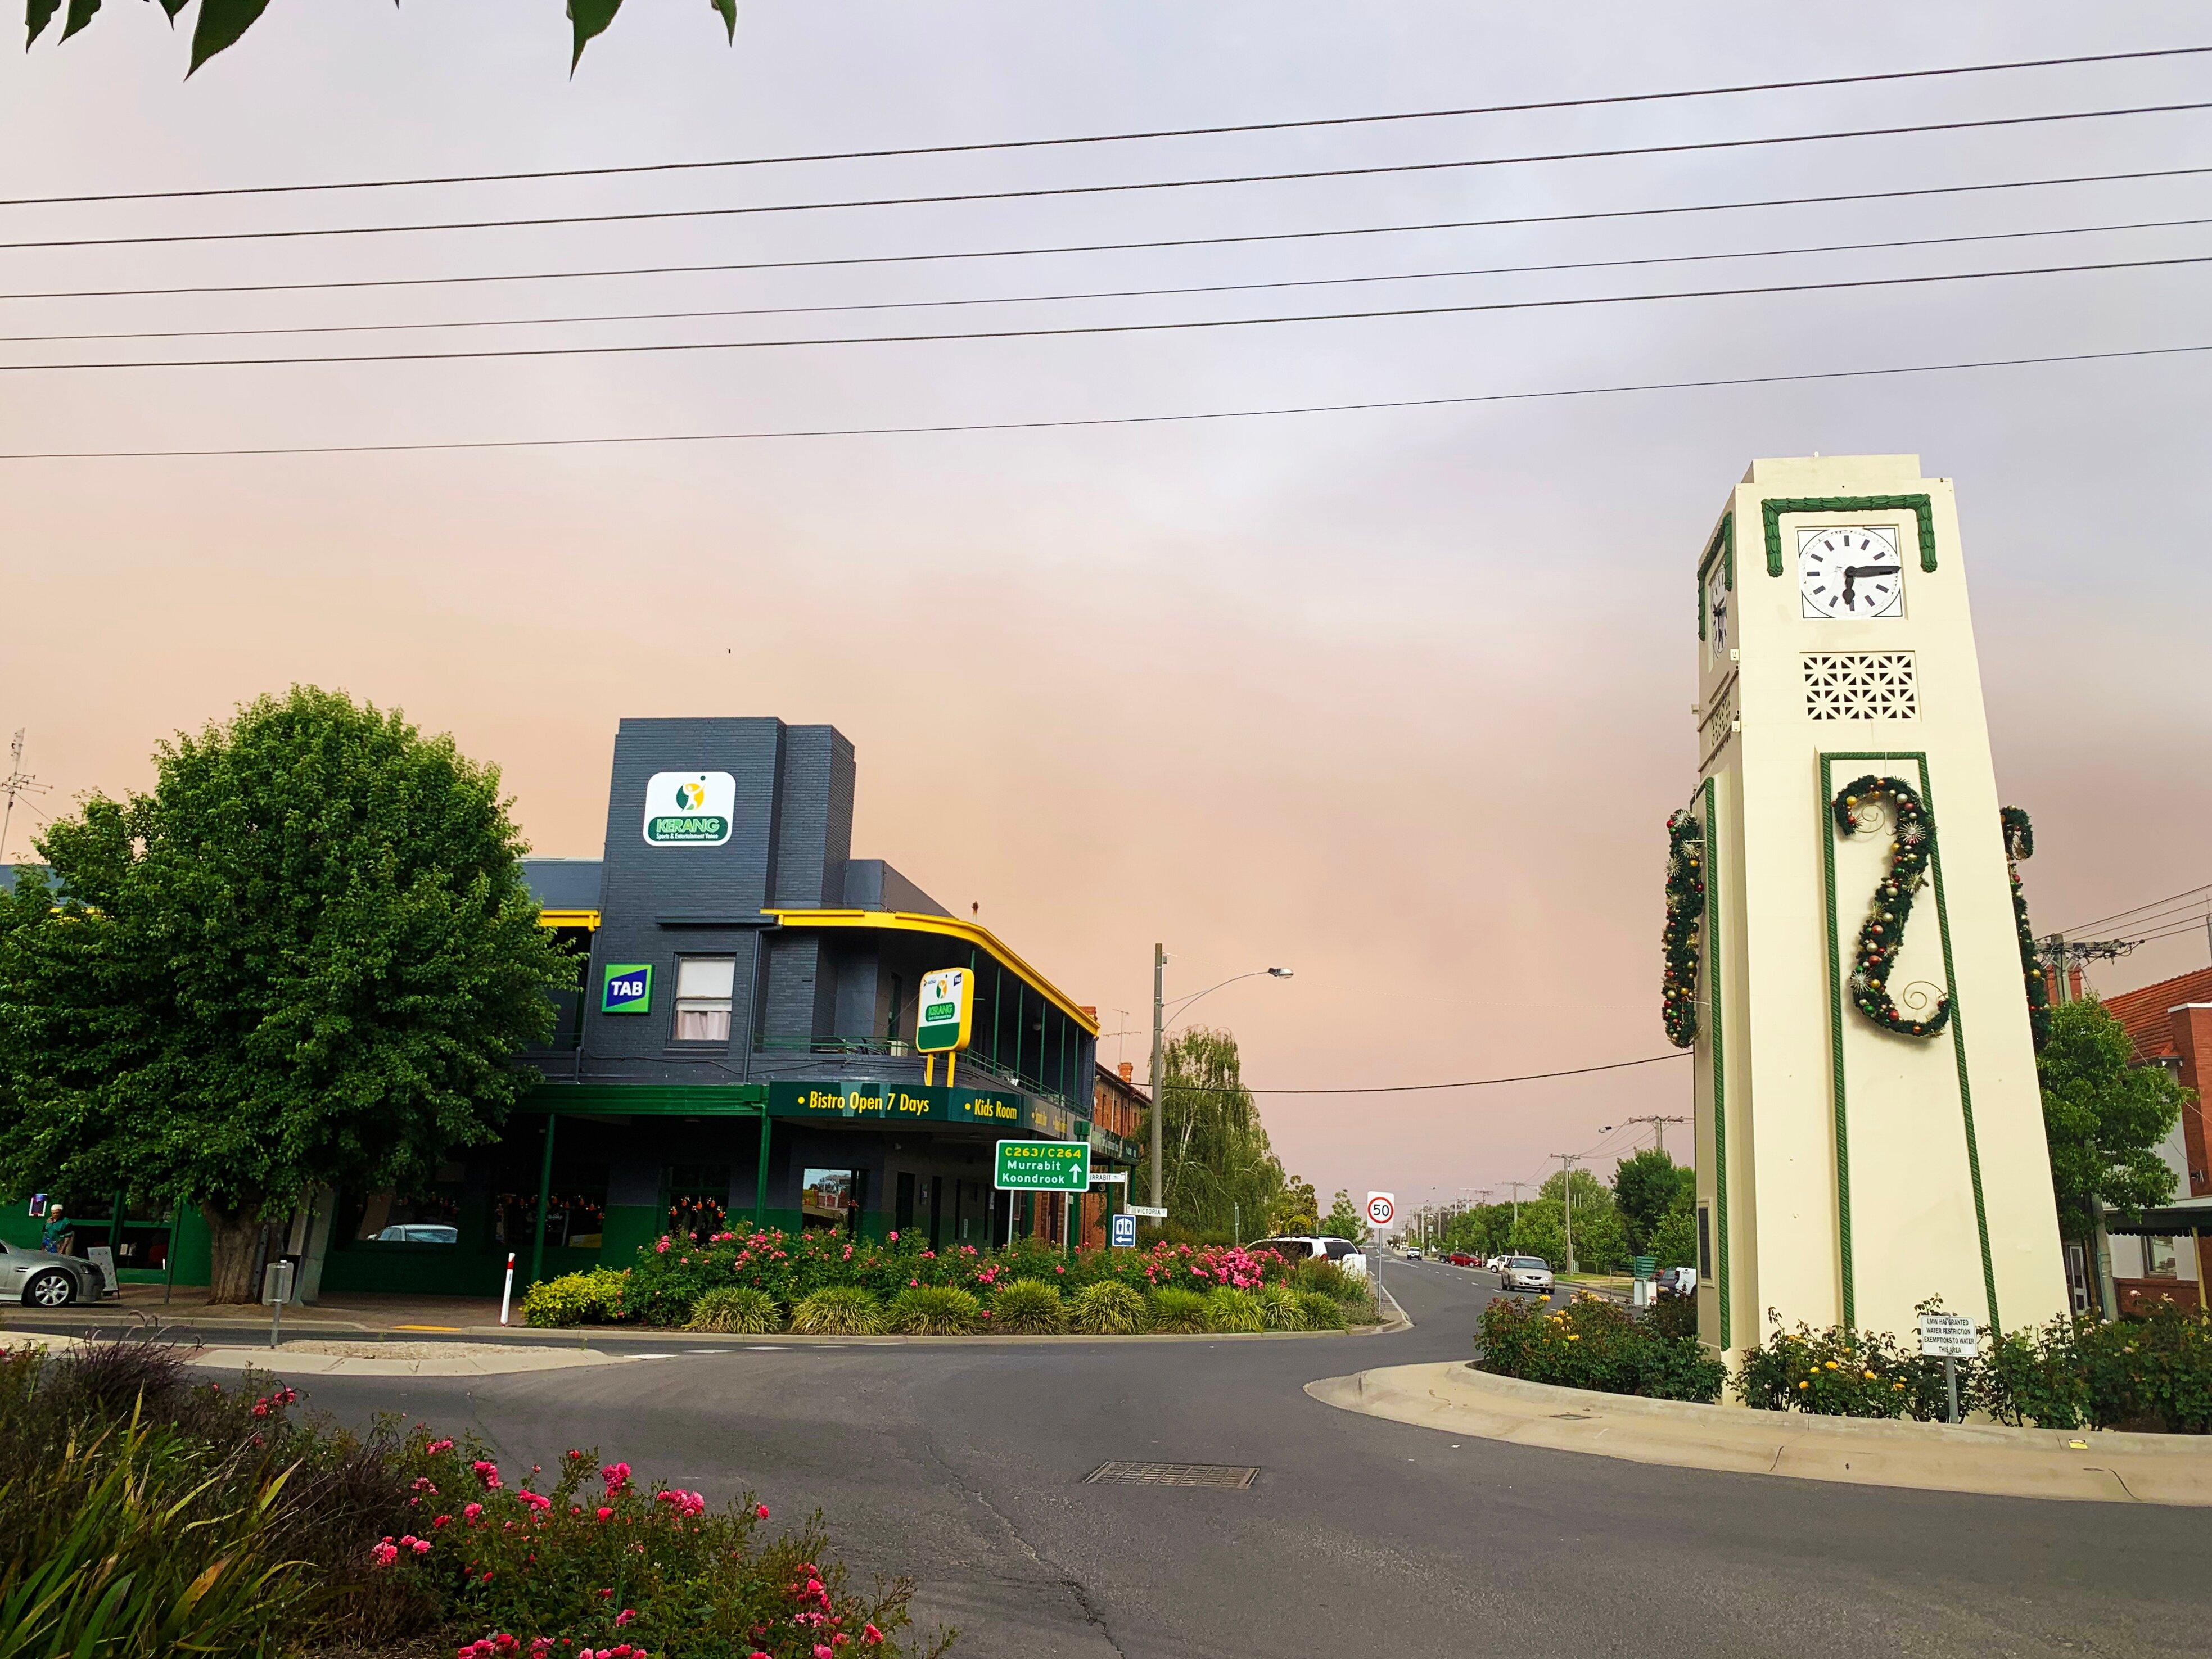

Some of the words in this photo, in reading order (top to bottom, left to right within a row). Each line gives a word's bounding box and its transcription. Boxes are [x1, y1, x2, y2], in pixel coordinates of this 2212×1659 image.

[656, 818, 720, 833] KERANG
[611, 981, 643, 996] TAB
[809, 1091, 845, 1109] Bistro
[849, 1091, 883, 1114] Open
[886, 1093, 896, 1110] 7
[900, 1093, 929, 1116] Days
[974, 1098, 994, 1117] Kids
[996, 1101, 1017, 1120] Room
[1005, 1147, 1081, 1159] C263/C264
[1007, 1160, 1061, 1171] Murrabit
[1002, 1173, 1065, 1184] Koondrook
[1373, 1204, 1389, 1217] 50
